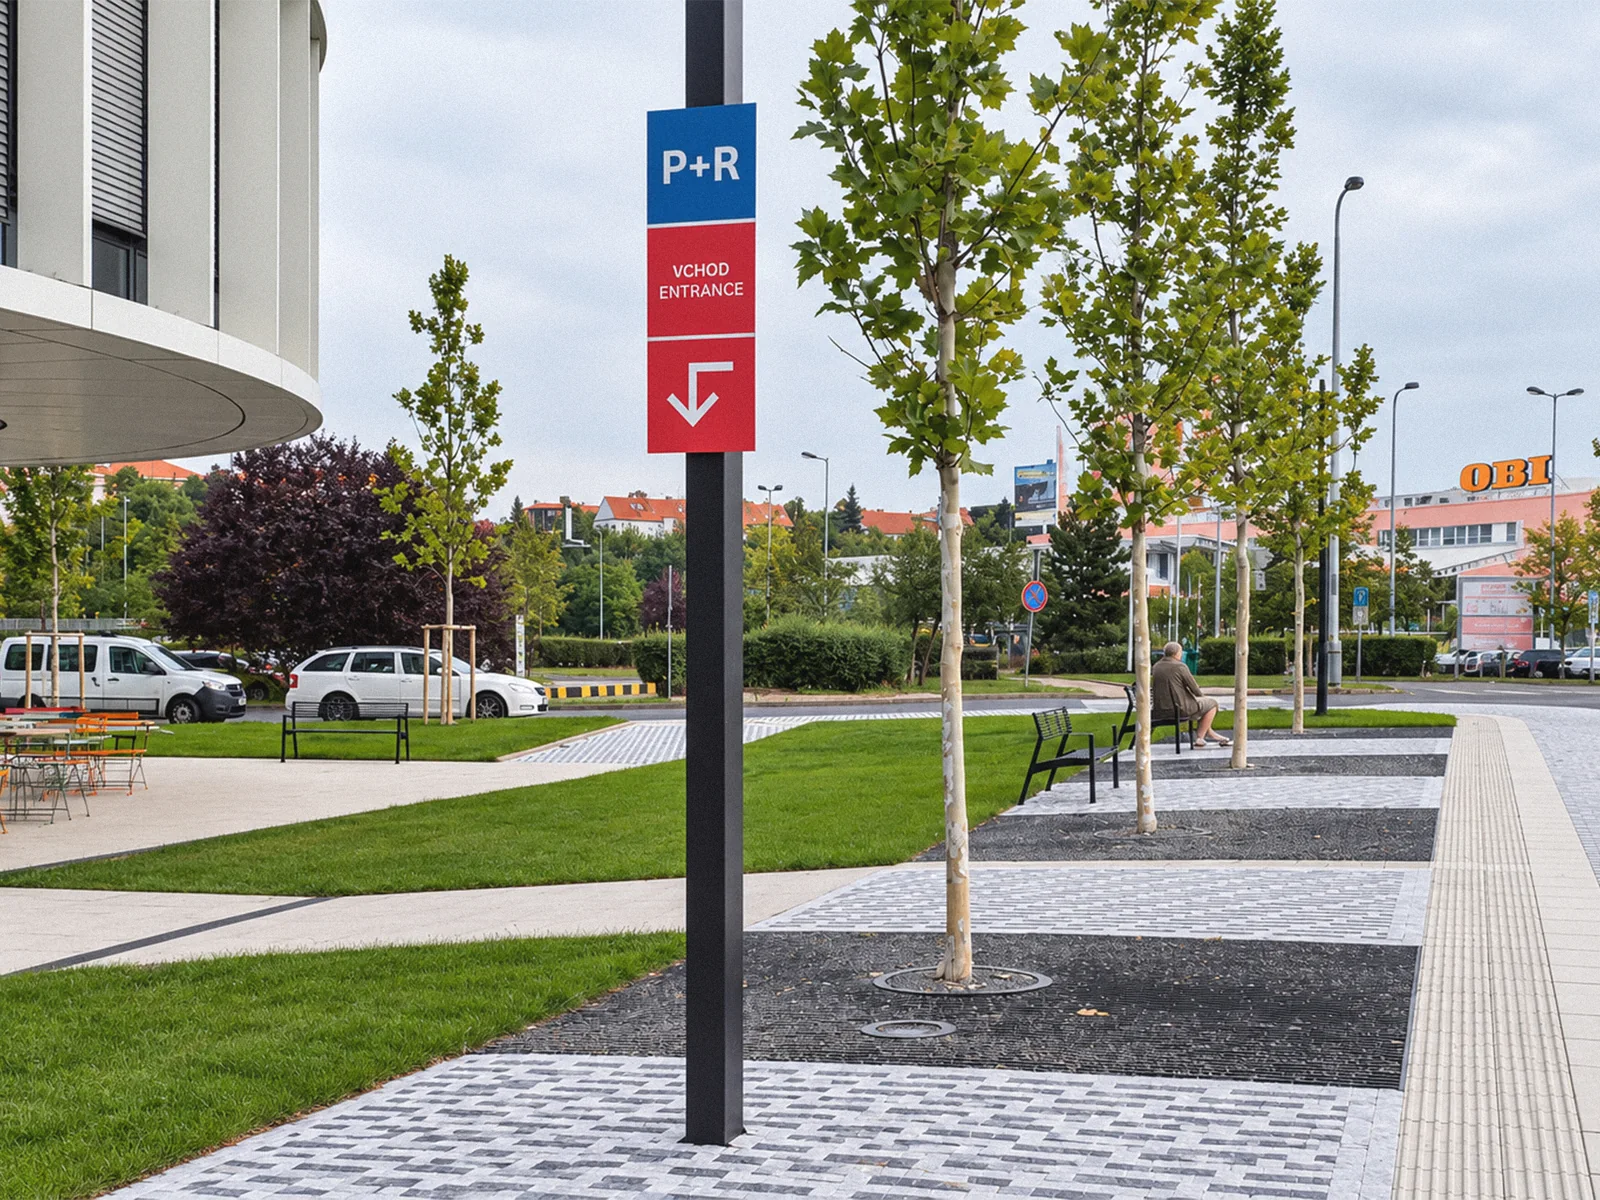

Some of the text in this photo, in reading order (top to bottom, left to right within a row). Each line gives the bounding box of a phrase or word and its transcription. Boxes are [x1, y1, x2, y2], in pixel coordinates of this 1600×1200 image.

[662, 145, 740, 185] P+R
[672, 261, 730, 278] VCHOD
[658, 281, 744, 300] ENTRANCE
[1460, 455, 1552, 492] OBI
